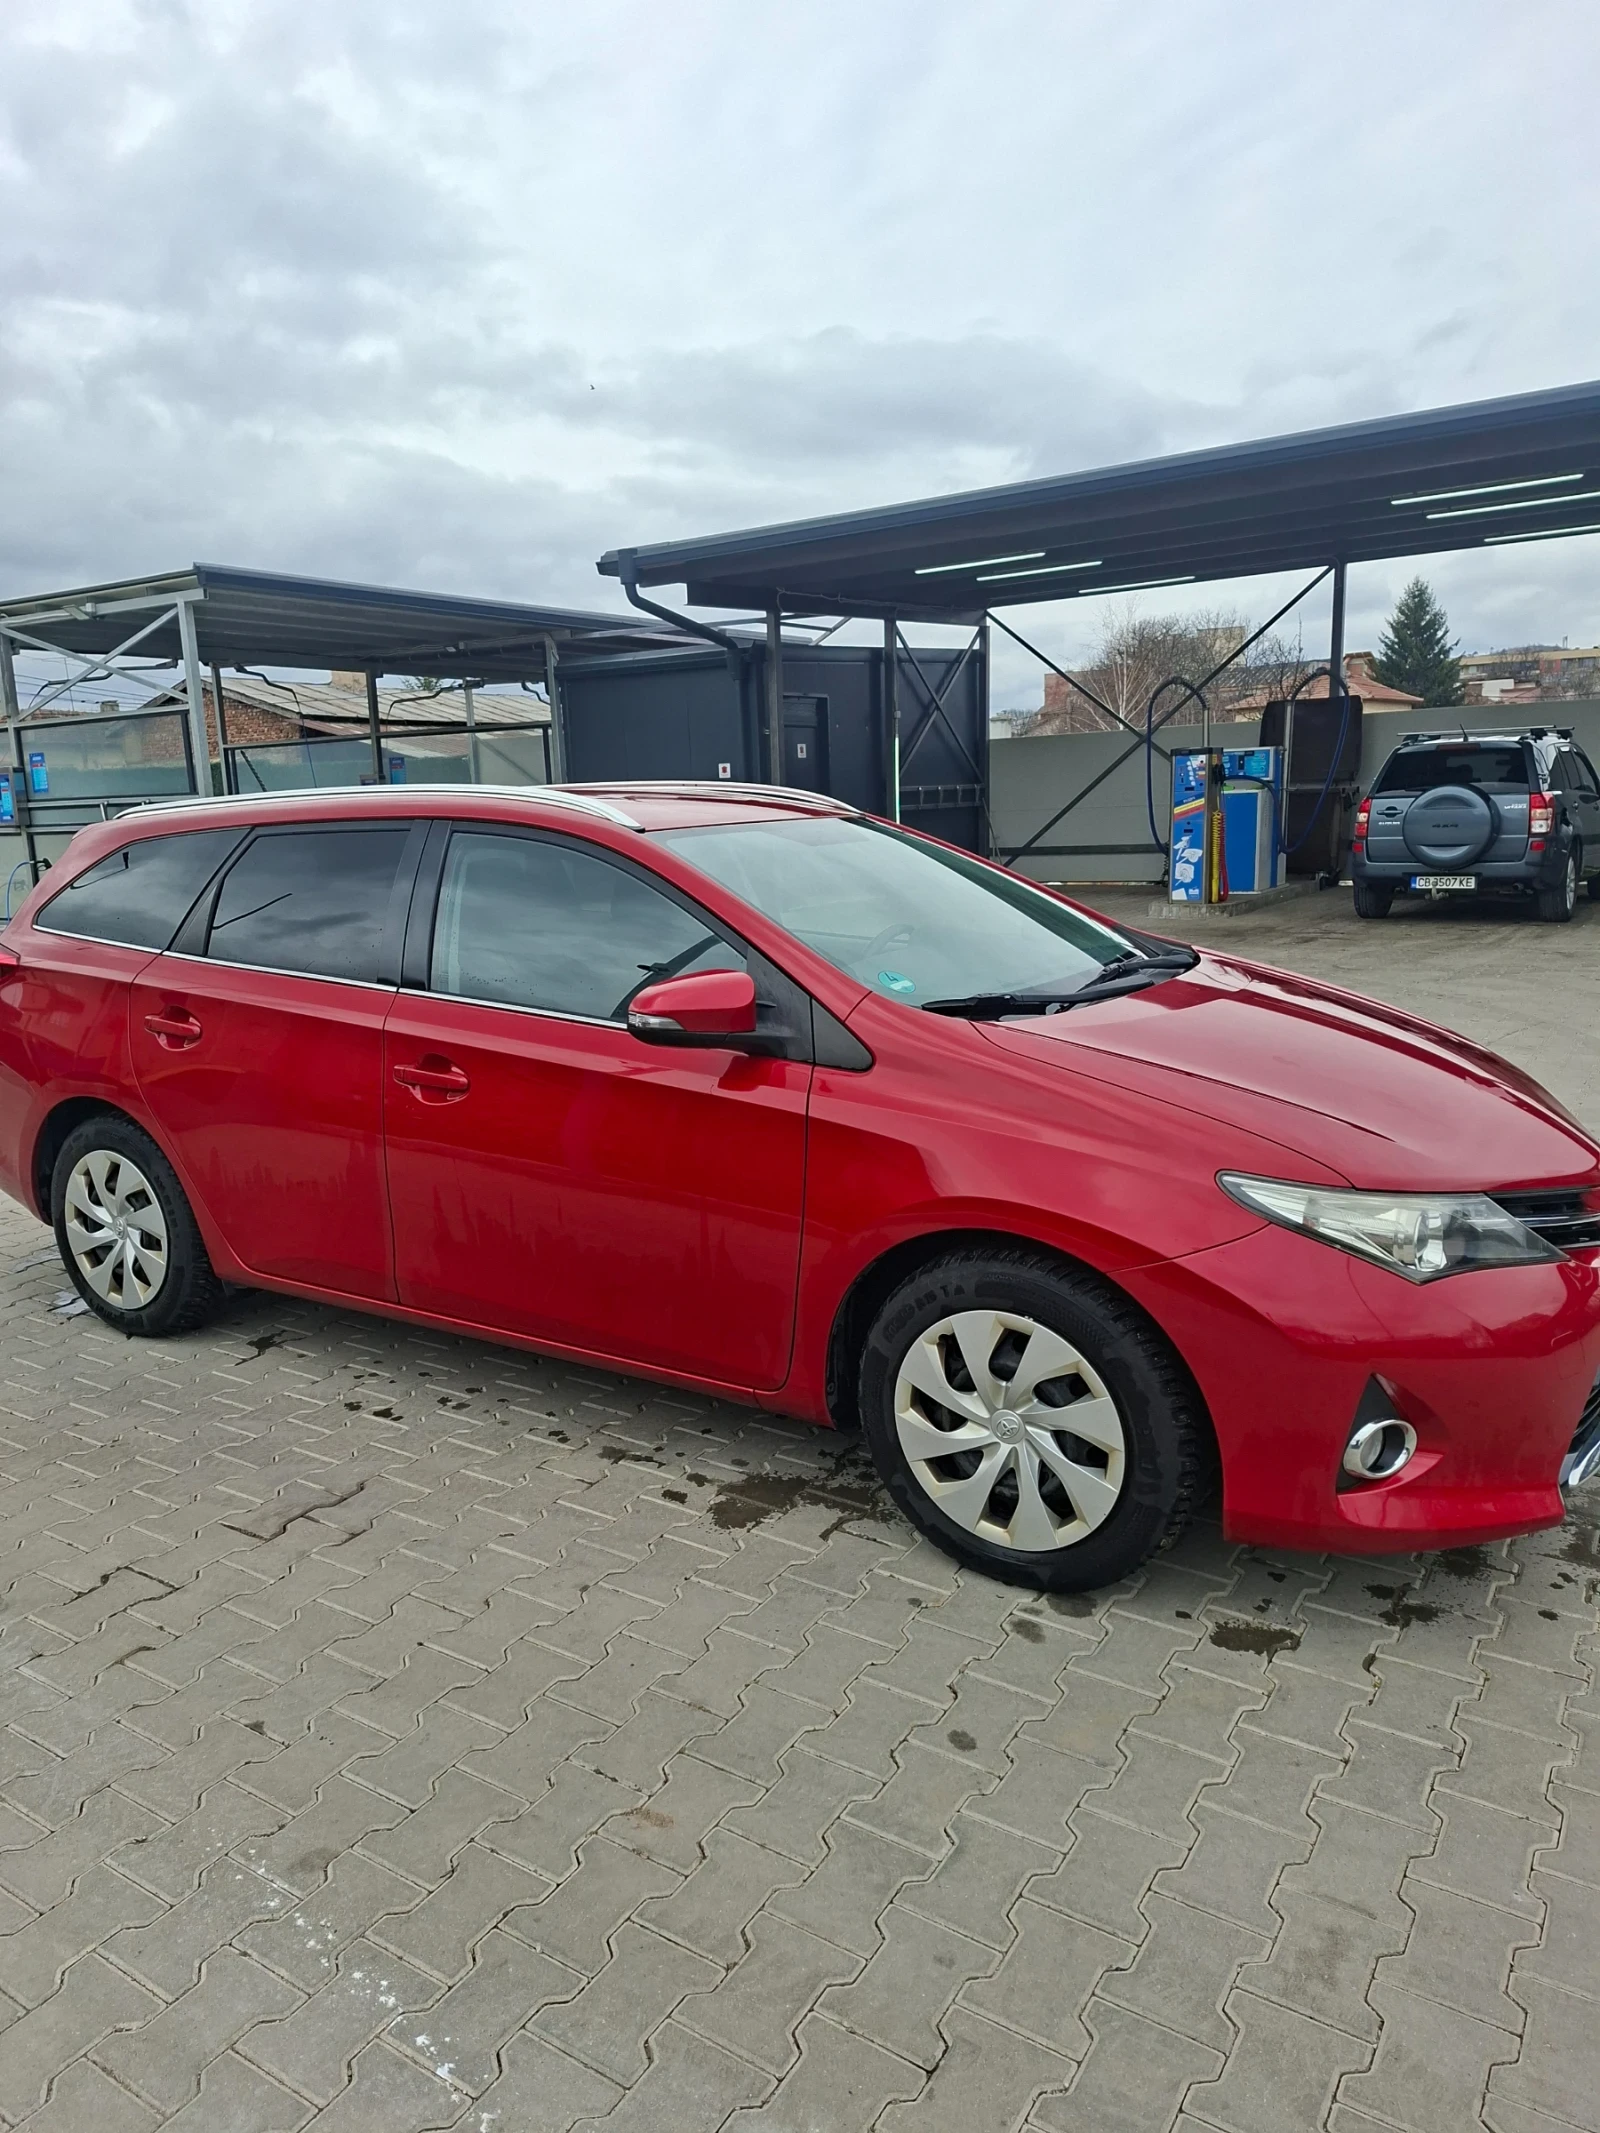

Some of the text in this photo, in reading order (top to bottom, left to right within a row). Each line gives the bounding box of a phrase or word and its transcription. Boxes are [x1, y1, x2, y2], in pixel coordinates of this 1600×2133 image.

[1418, 877, 1431, 887] CB
[1458, 877, 1473, 887] KE
[884, 972, 899, 982] 4
